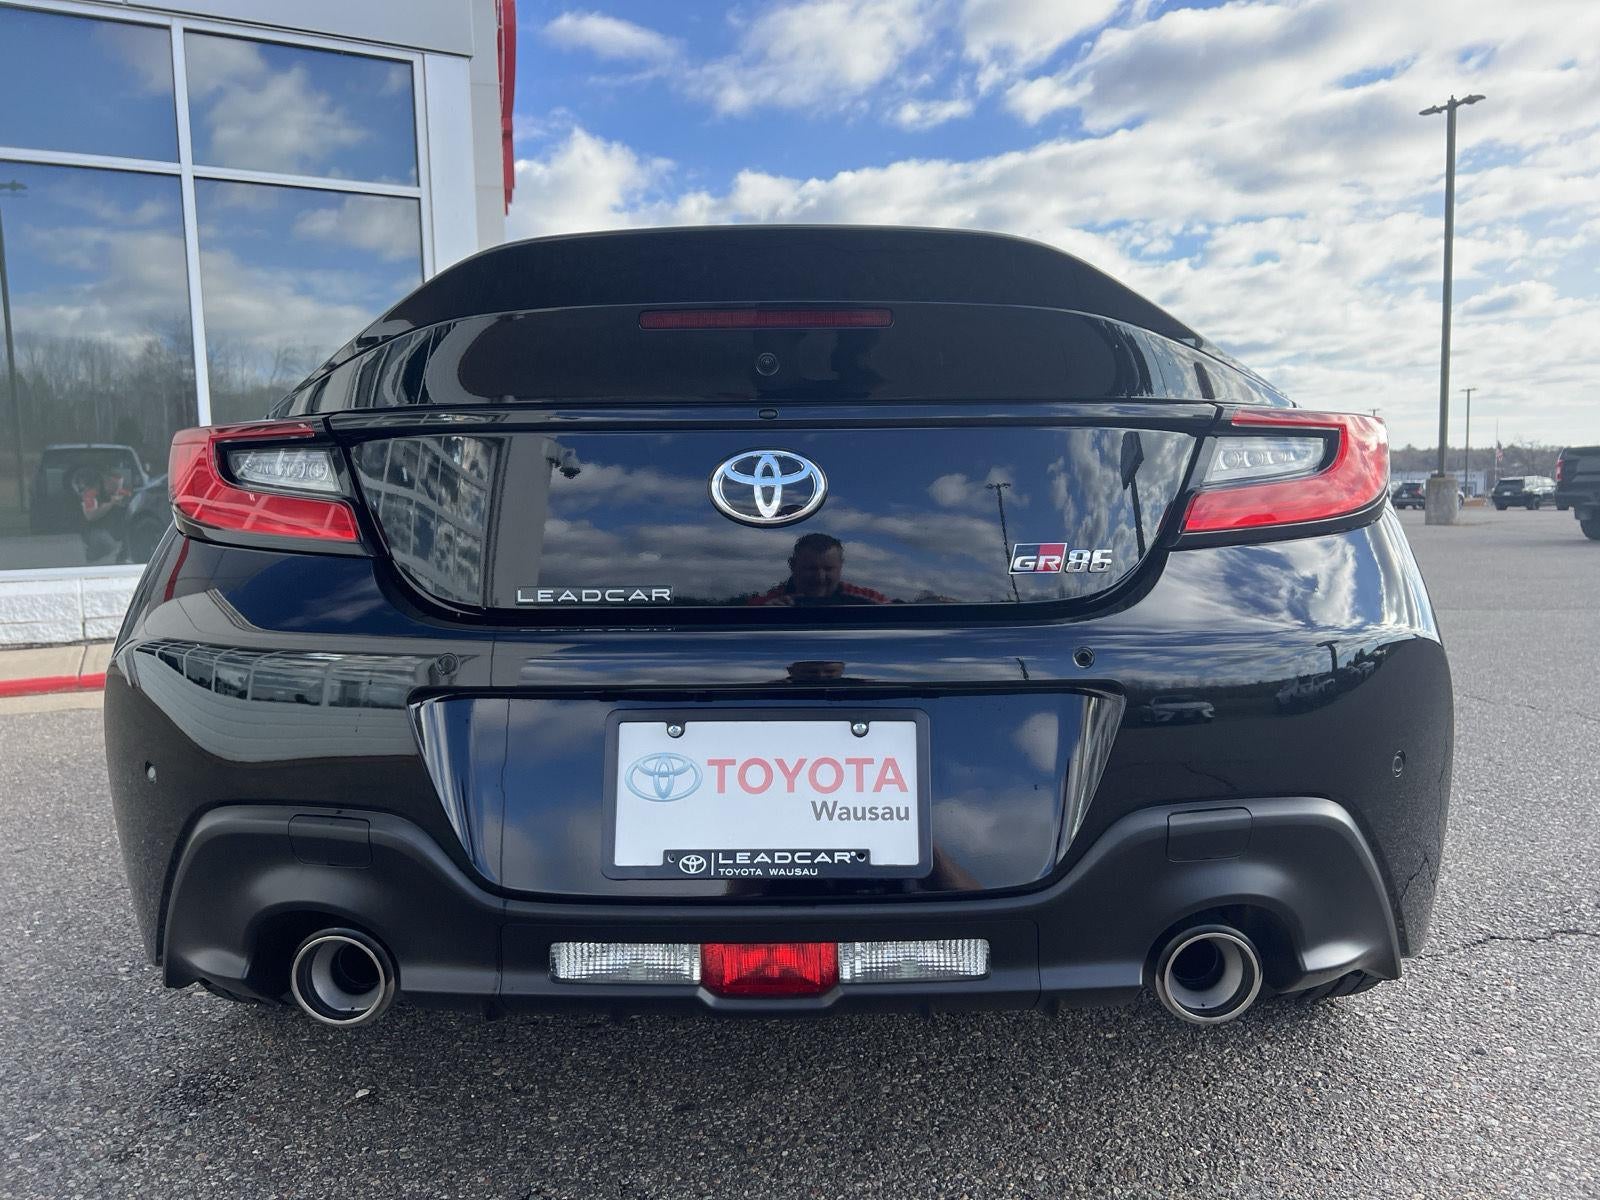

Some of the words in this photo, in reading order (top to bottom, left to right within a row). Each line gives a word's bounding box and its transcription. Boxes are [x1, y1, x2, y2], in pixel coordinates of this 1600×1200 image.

[1012, 555, 1061, 571] GR
[1066, 549, 1113, 573] 86
[517, 588, 671, 602] LEADCAR
[707, 757, 909, 794] TOYOTA
[811, 800, 910, 821] Wausau
[718, 868, 763, 876] TOYOTA
[769, 868, 818, 876] WAUSAU
